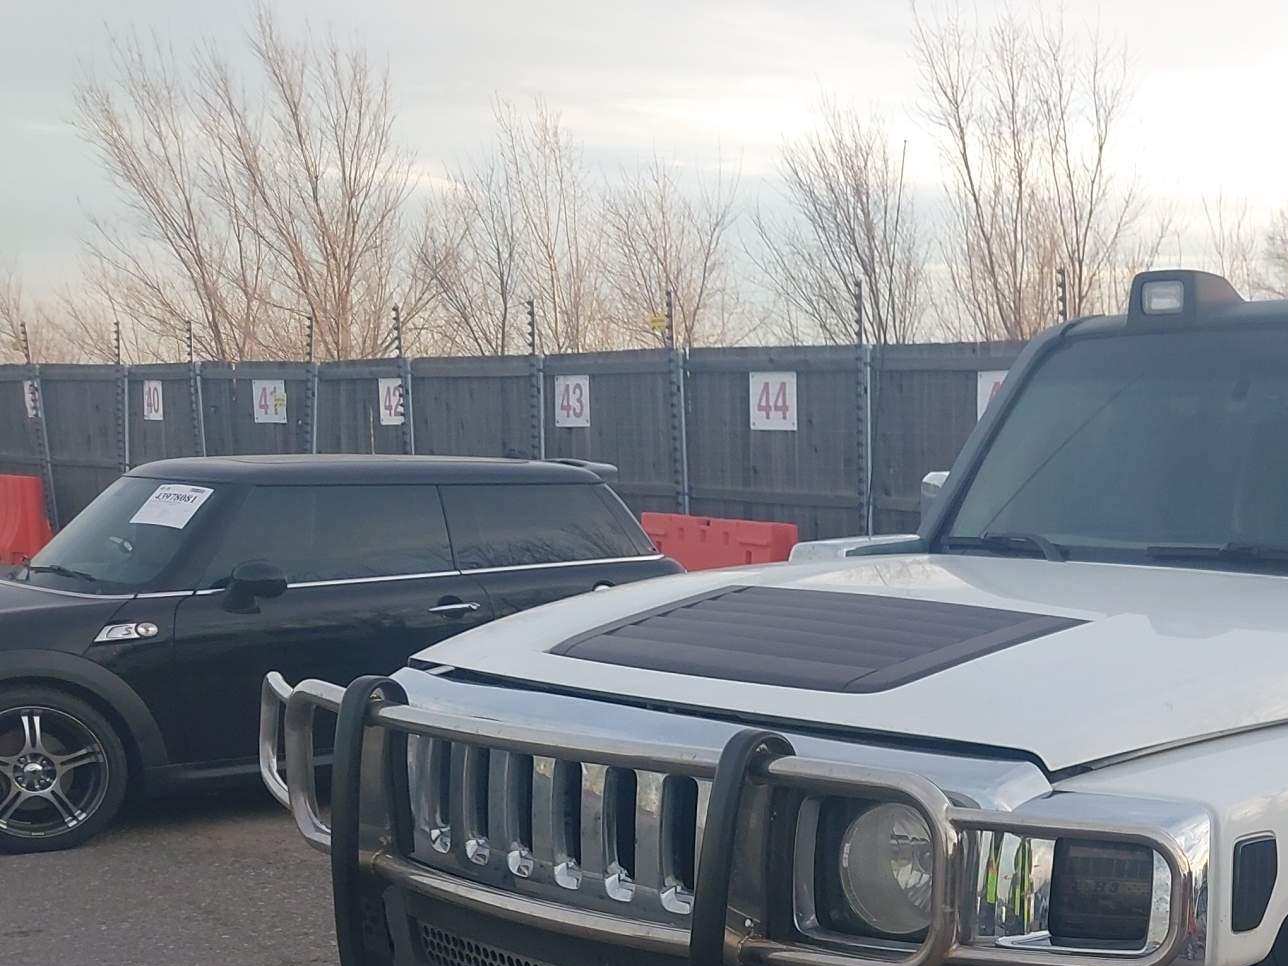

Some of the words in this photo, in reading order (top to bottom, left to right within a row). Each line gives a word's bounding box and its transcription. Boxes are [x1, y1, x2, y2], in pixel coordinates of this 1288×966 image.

[384, 385, 403, 417] 42
[560, 383, 584, 418] 43
[757, 382, 789, 420] 44
